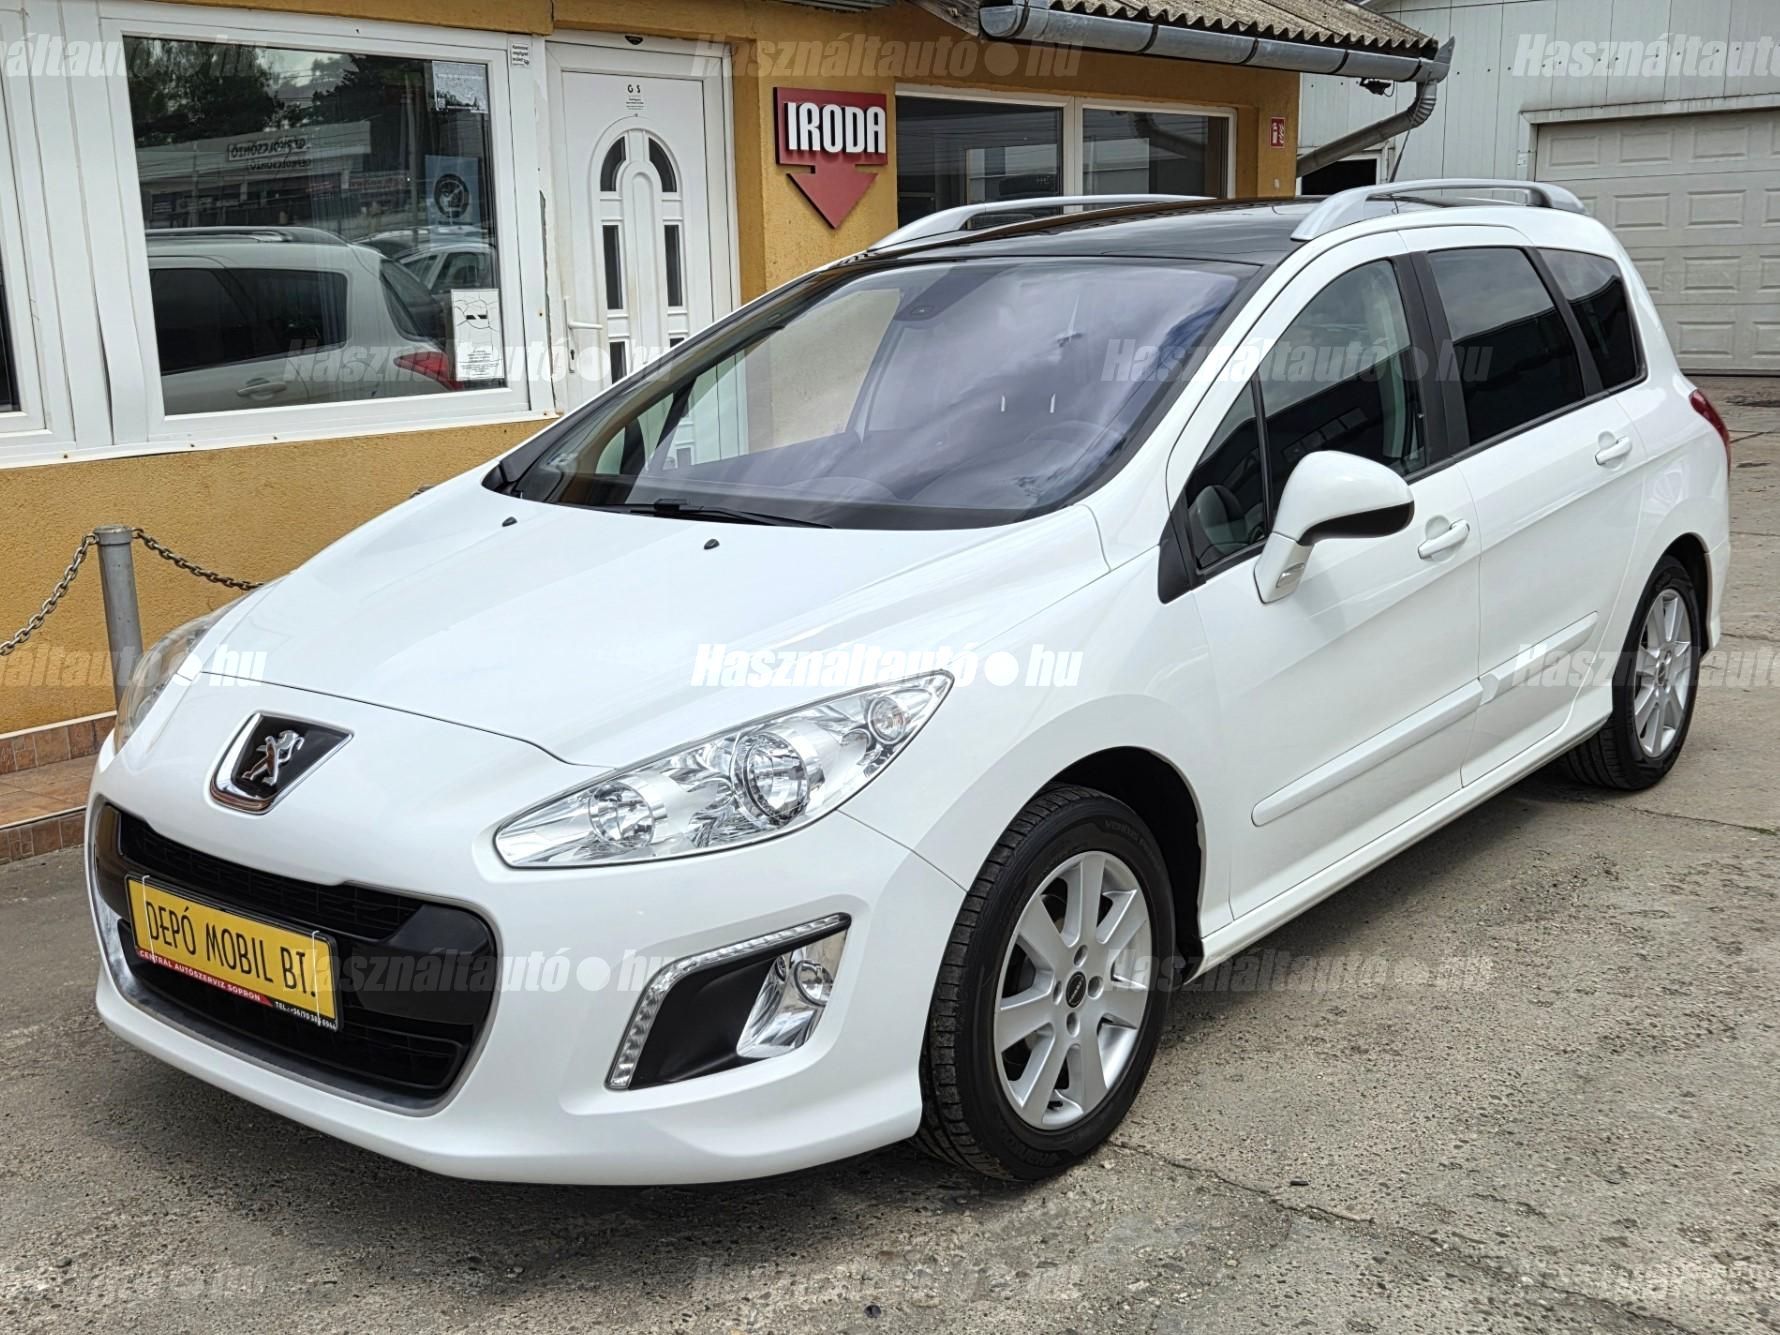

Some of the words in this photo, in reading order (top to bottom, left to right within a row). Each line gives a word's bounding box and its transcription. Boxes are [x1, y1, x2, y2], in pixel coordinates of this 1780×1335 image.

[786, 102, 886, 154] IRODA
[145, 901, 197, 955] DEPÓ
[206, 922, 274, 983] MOBIL
[227, 983, 261, 1001] SOPRON
